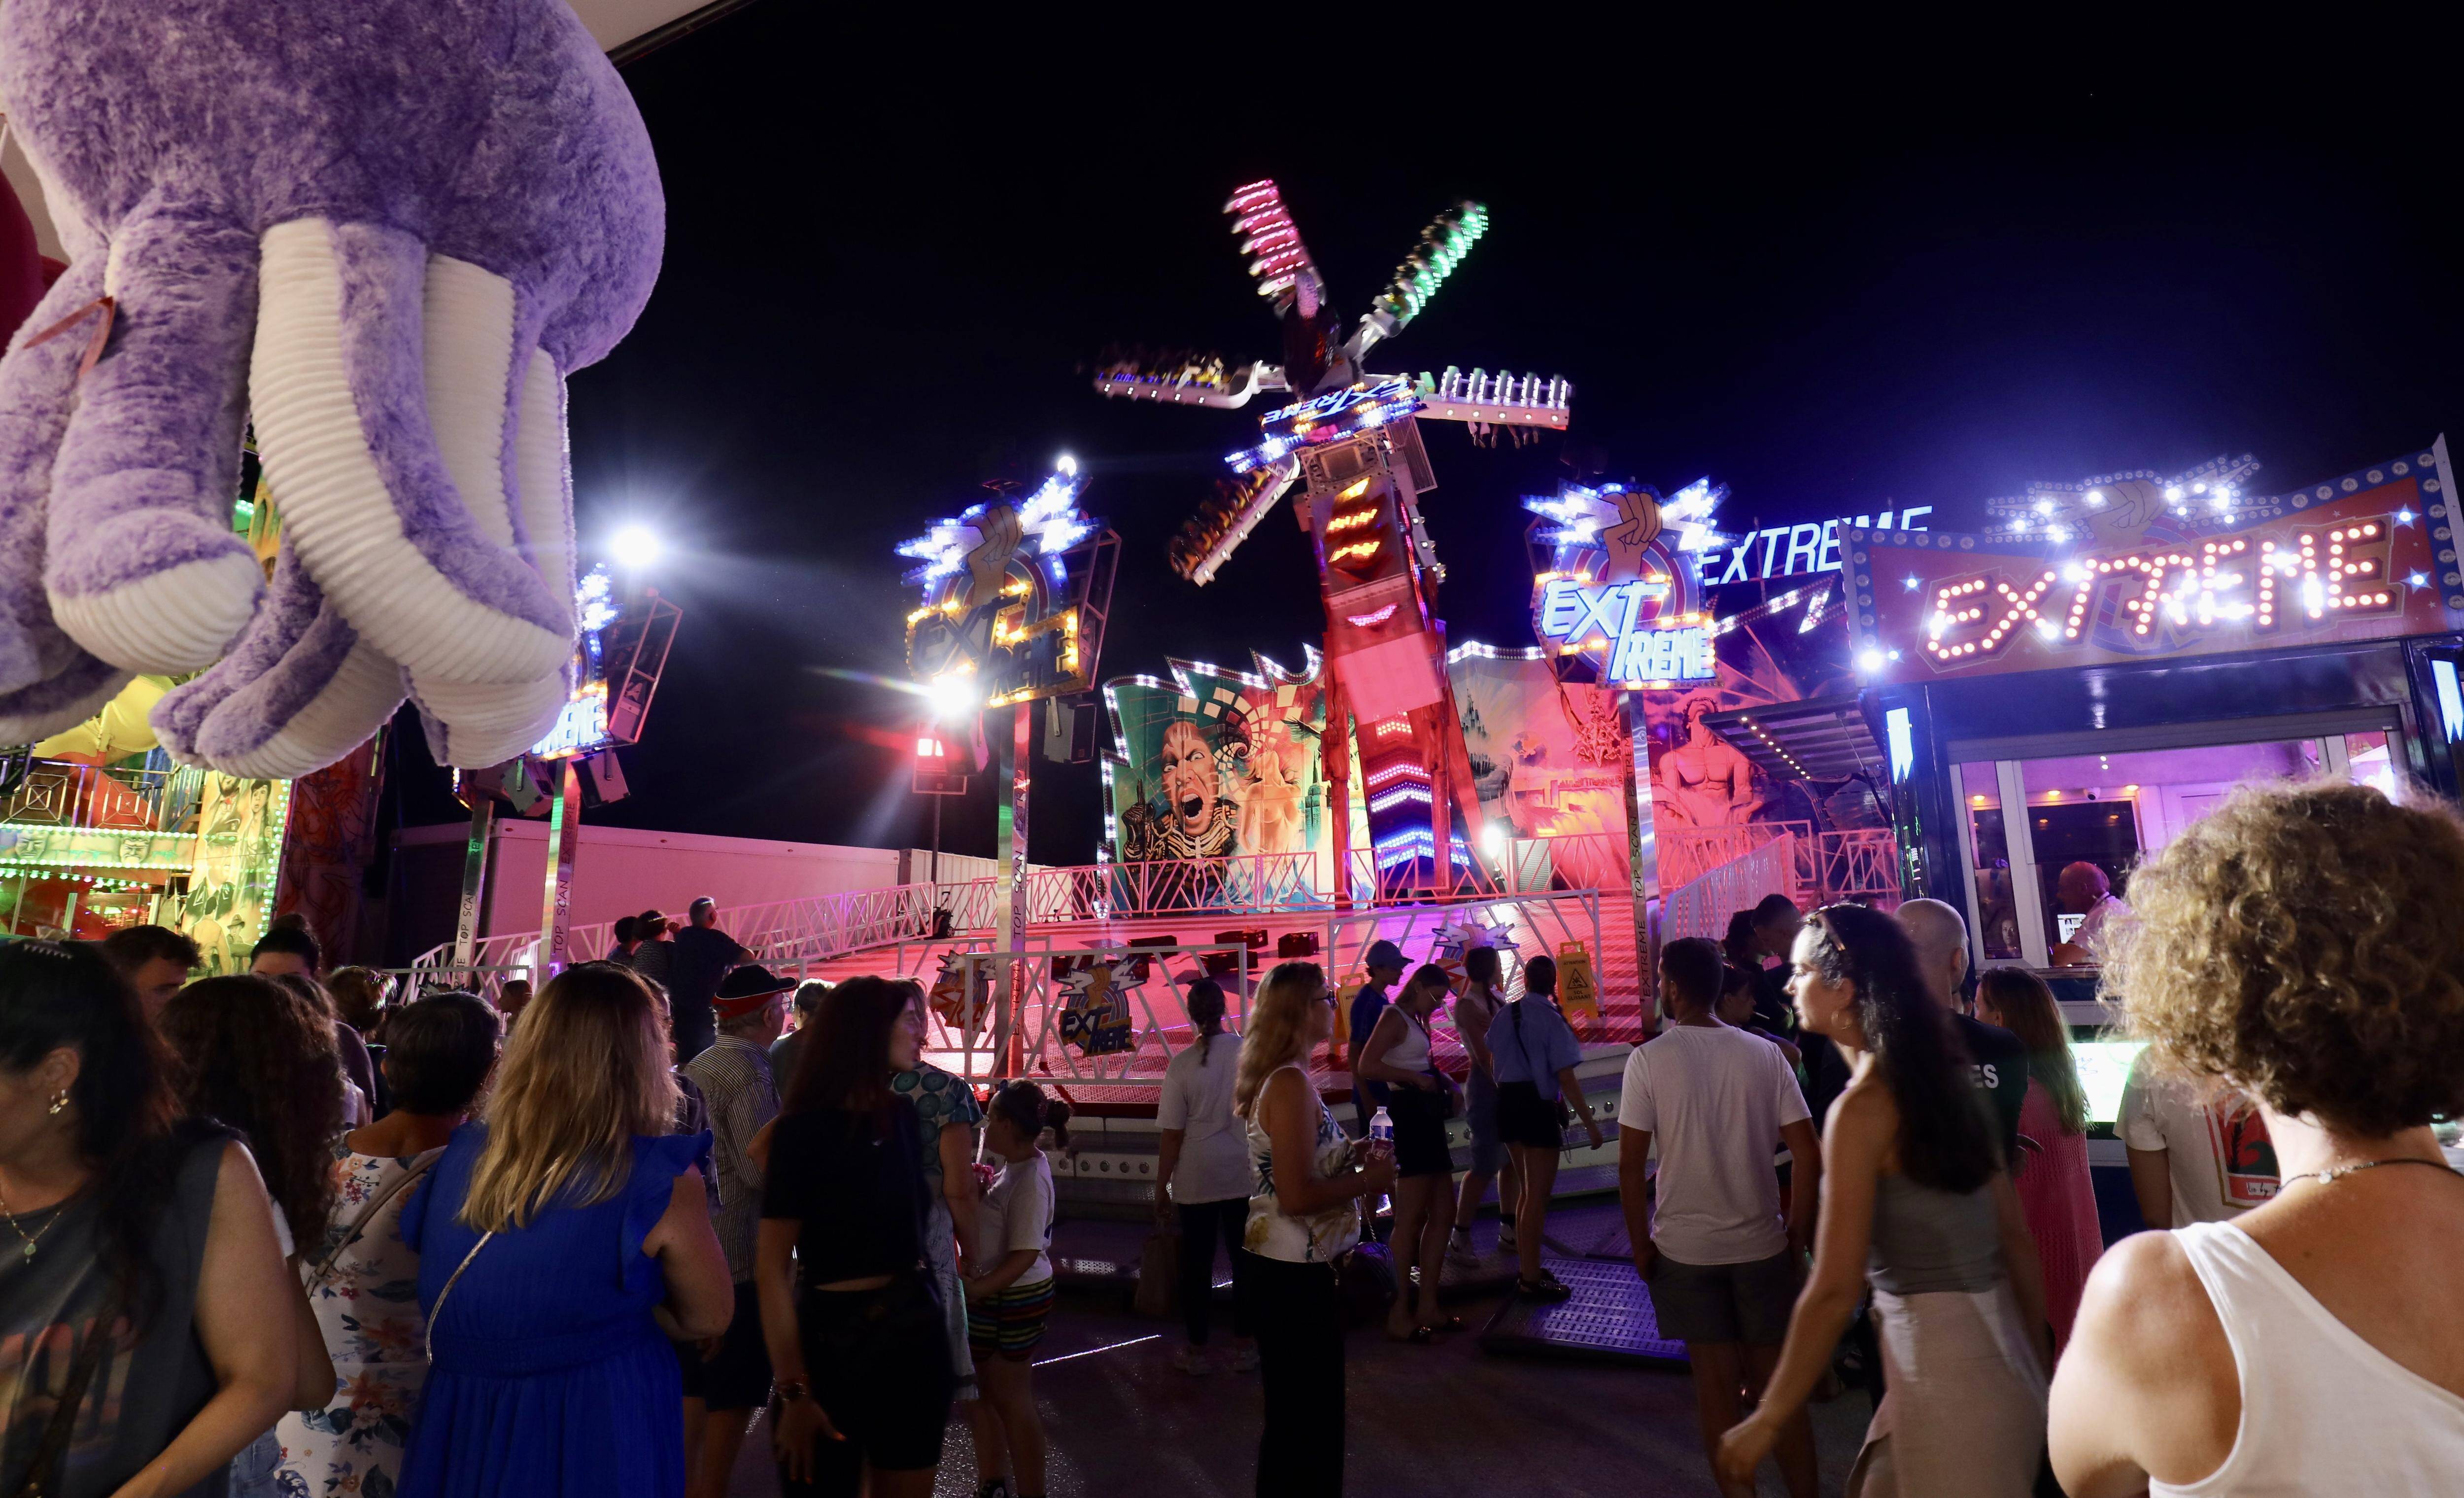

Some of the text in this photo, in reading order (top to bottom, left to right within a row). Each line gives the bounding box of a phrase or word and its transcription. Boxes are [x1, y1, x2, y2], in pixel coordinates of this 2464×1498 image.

[1262, 379, 1410, 425] EXTREME
[1926, 520, 2394, 664] EXTREME
[1623, 727, 1643, 902] TOP SCAN EXTREME
[553, 802, 575, 954] TOP SCAN EXTREME
[1638, 920, 1651, 997] EXTREME
[1970, 1064, 1999, 1088] ES
